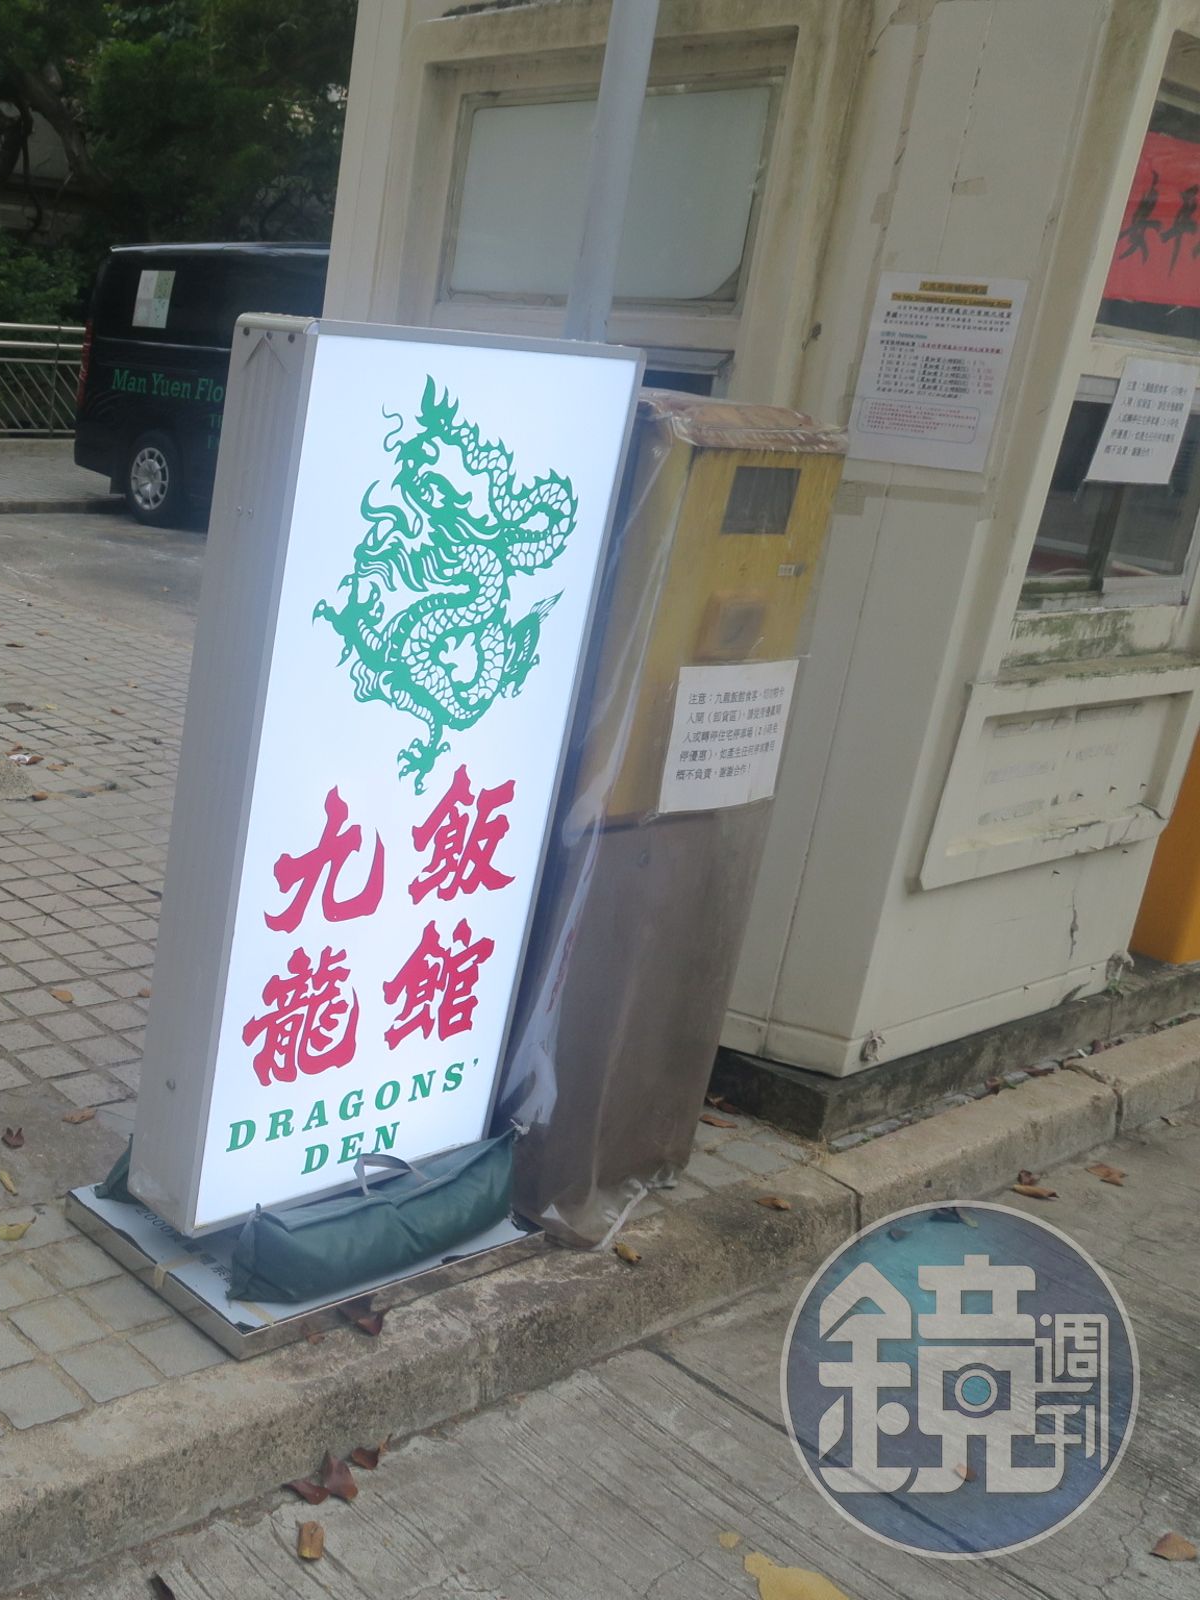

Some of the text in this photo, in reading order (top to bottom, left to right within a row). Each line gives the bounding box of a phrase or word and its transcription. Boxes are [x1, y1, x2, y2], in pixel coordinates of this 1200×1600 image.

[112, 368, 224, 403] Man Yuen Flo
[226, 1058, 480, 1153] DRAGONS'
[300, 1121, 400, 1176] DEN
